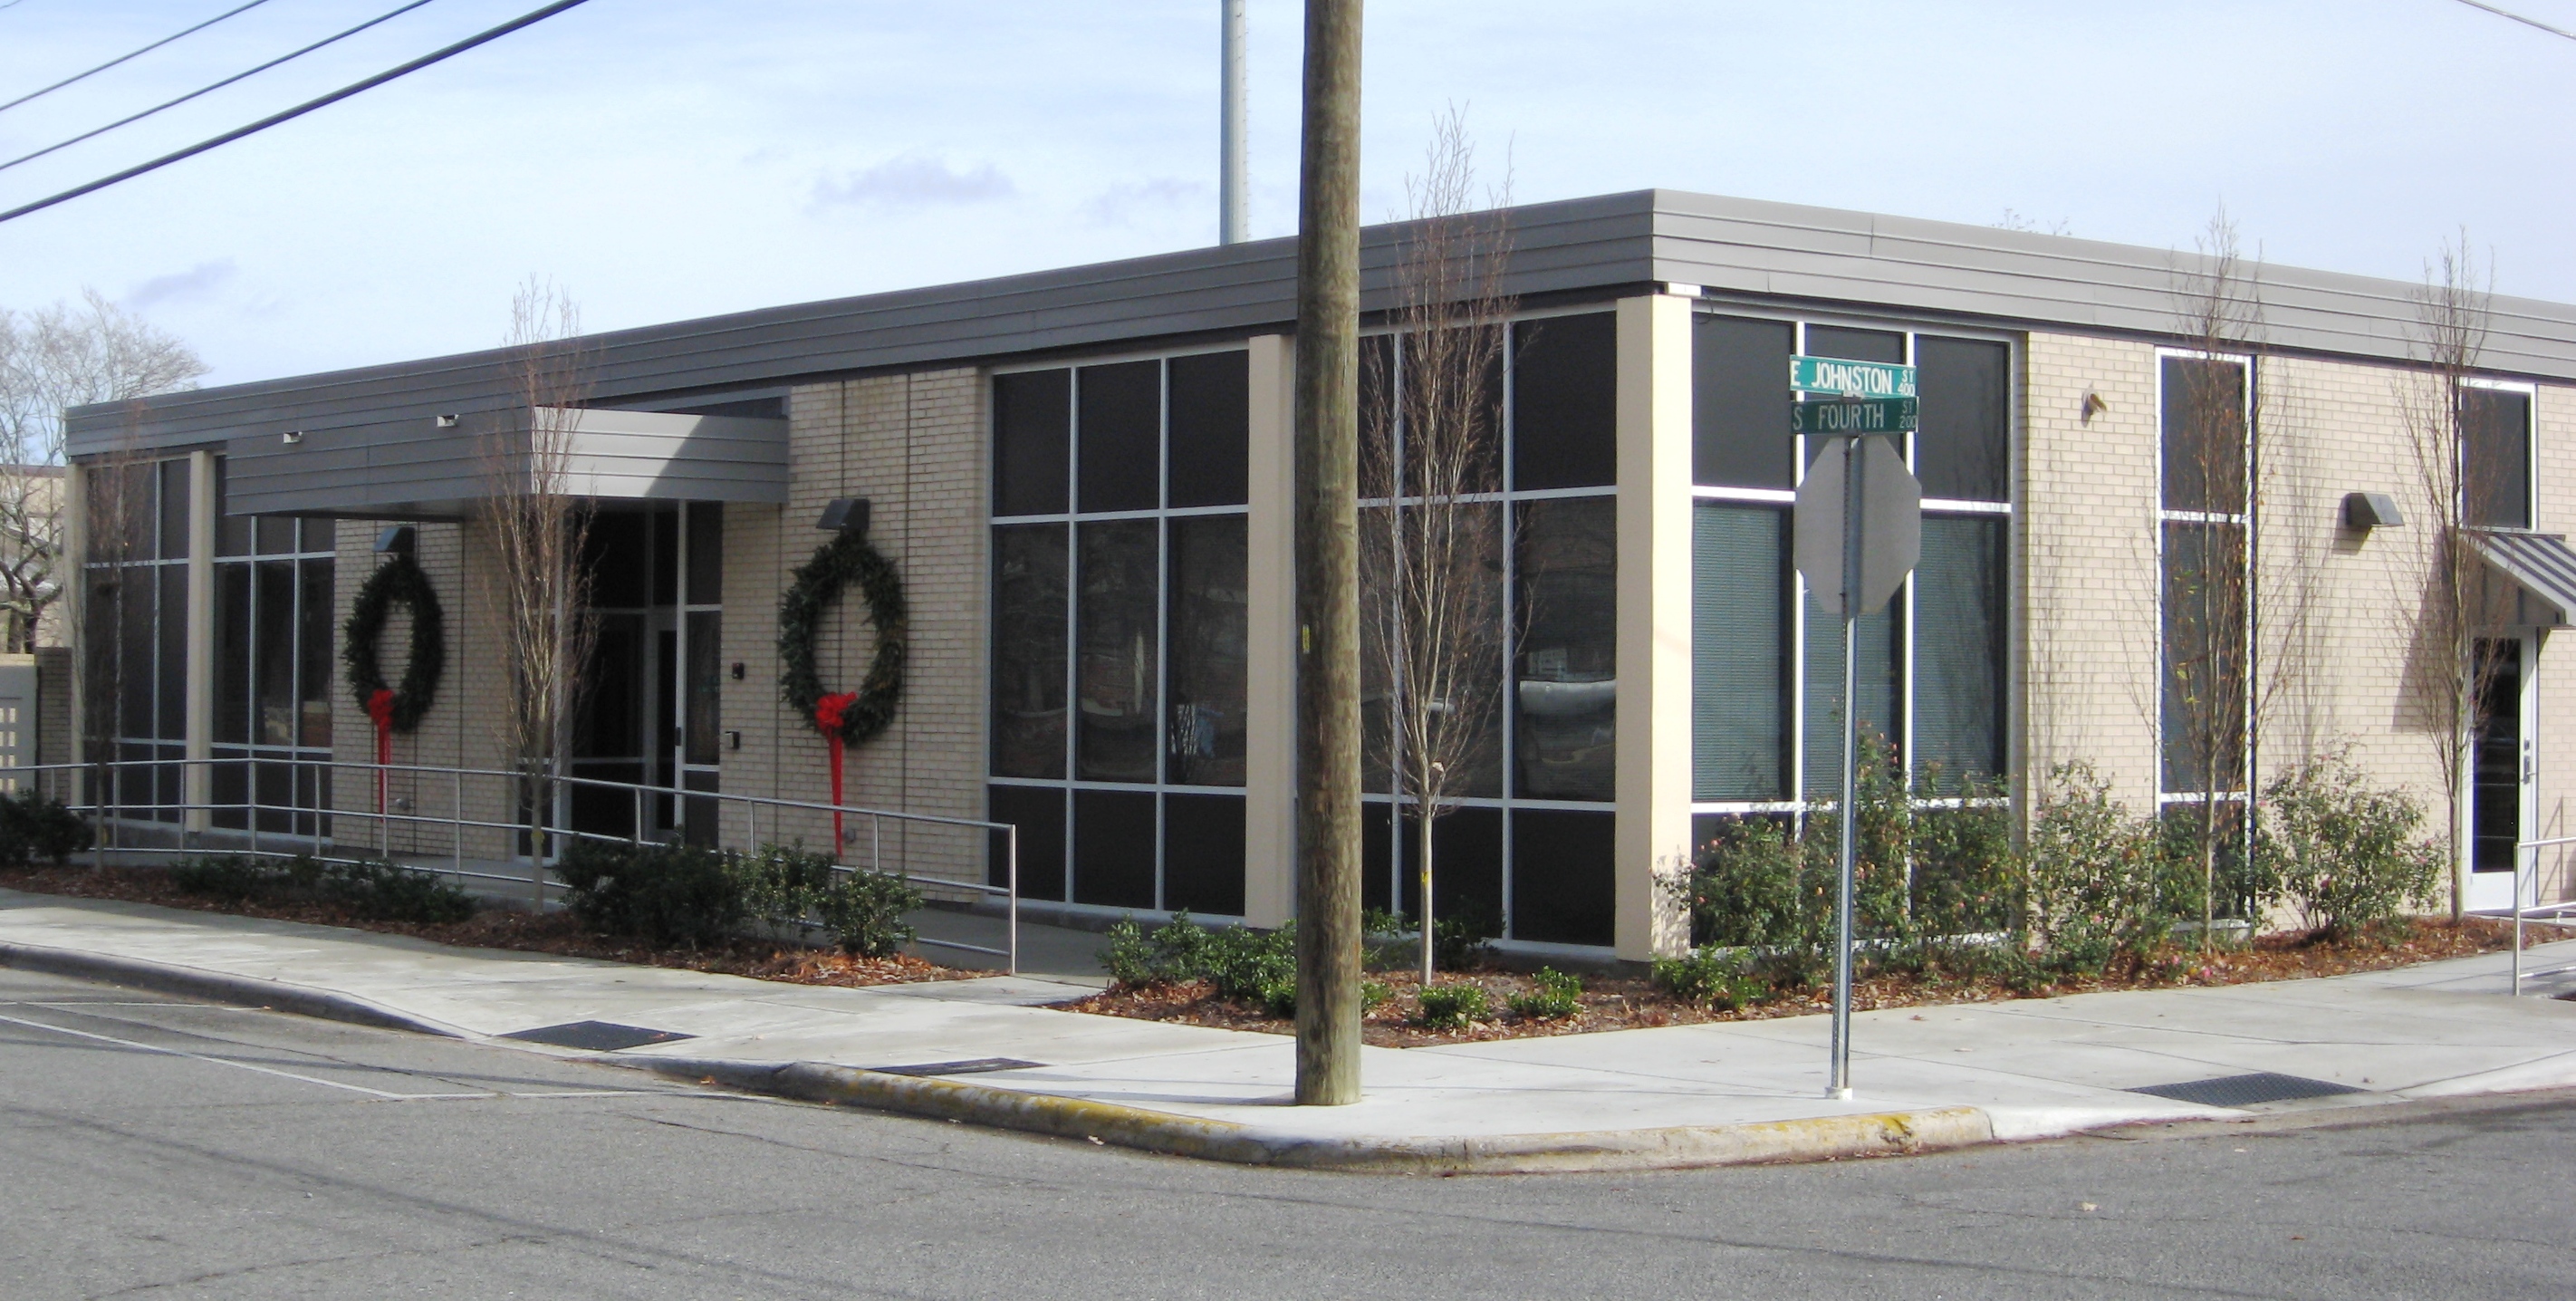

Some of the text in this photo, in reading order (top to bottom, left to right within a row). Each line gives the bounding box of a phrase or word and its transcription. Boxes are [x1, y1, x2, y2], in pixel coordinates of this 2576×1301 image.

[1790, 361, 1914, 394] E JOHNSTON ST
[1898, 383, 1916, 397] 400
[1793, 400, 1913, 430] S FOURTH ST
[1899, 416, 1918, 429] 200
